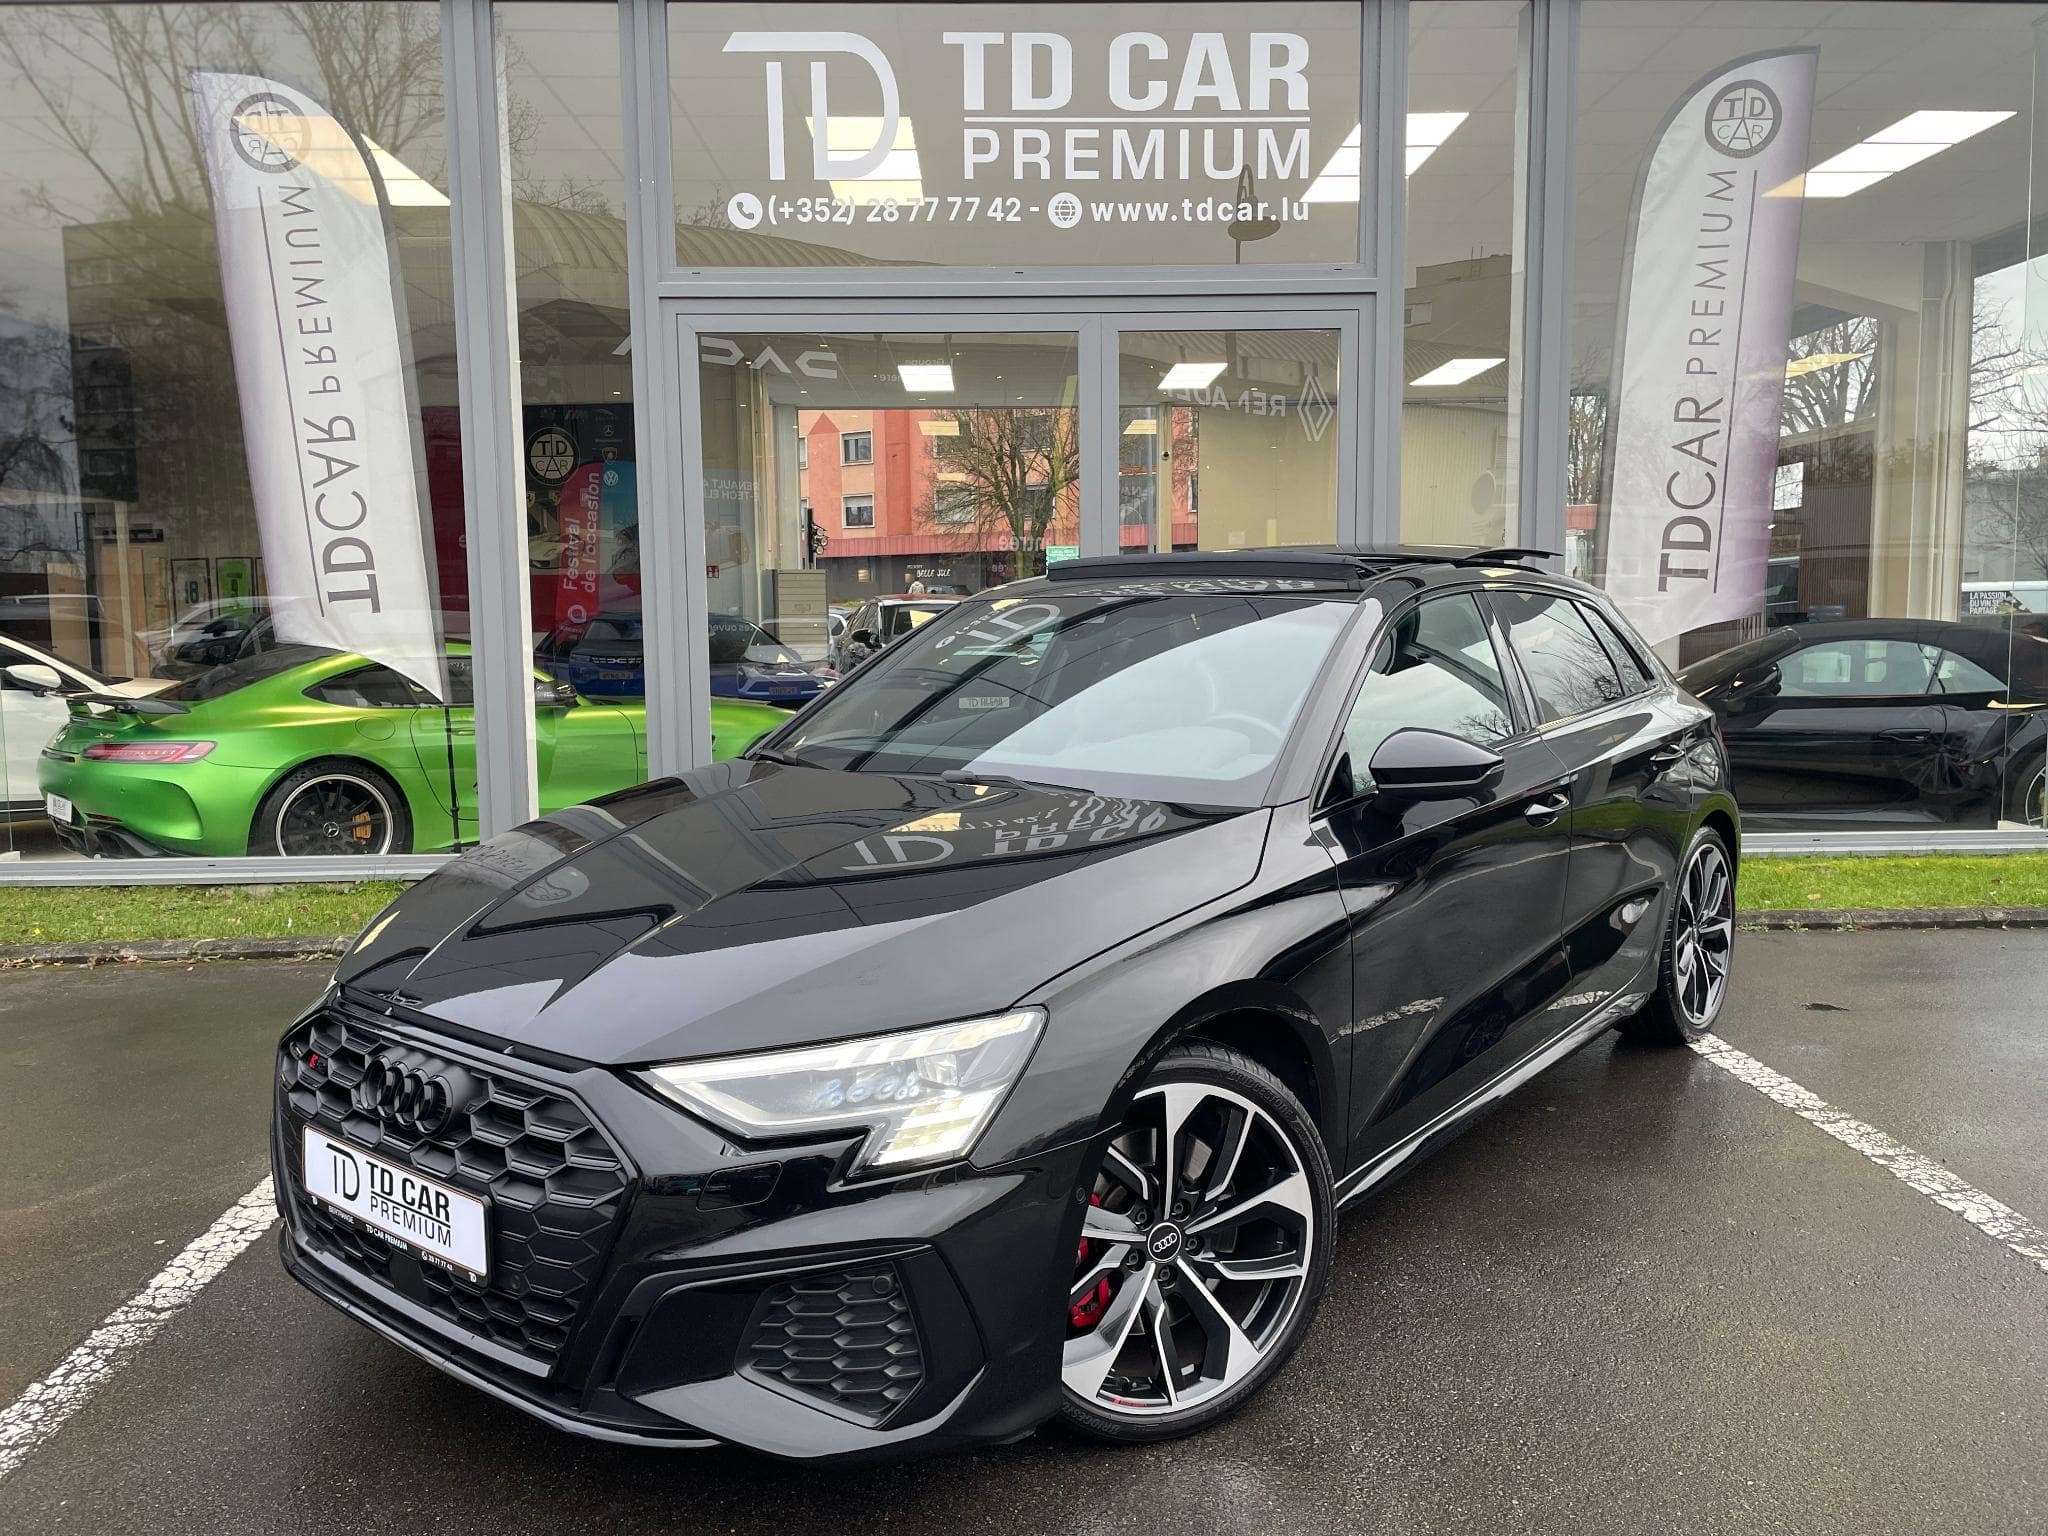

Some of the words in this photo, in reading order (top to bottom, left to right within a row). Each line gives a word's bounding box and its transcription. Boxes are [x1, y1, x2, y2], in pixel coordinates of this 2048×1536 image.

[942, 32, 1073, 111] TD
[1109, 31, 1310, 111] CAR
[964, 128, 1310, 180] PREMIUM
[768, 195, 856, 225] (+352)
[866, 197, 900, 222] 28
[906, 197, 939, 222] 77
[947, 197, 980, 222] 77
[987, 197, 1021, 222] 42
[1090, 197, 1310, 222] www.tdcar.lu
[1685, 169, 1739, 376] PREMIUM
[536, 457, 568, 478] CAR
[537, 440, 568, 455] TD
[1657, 395, 1724, 592] TDCAR
[581, 568, 596, 593] de
[1980, 592, 2007, 600] PASSION
[366, 1160, 394, 1197] TD
[401, 1177, 451, 1223] CAR
[370, 1198, 451, 1248] PREMIUM
